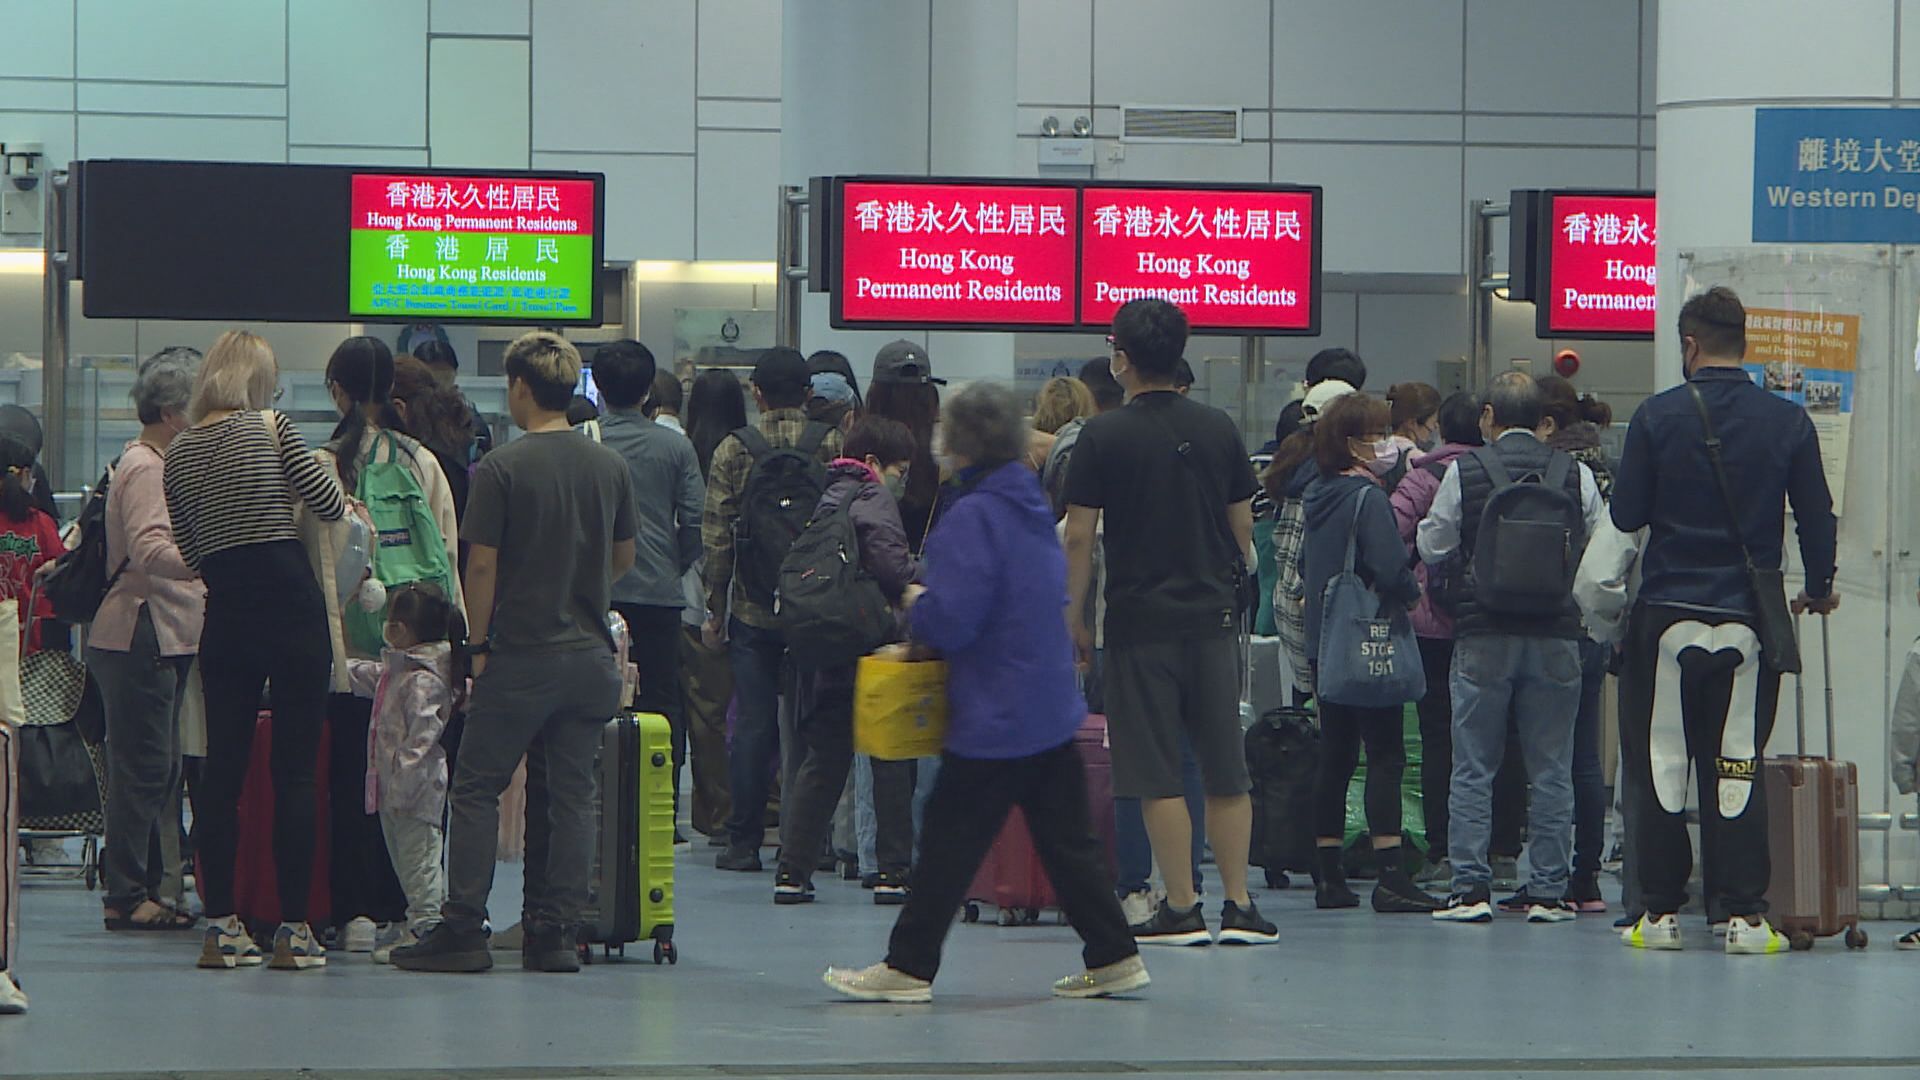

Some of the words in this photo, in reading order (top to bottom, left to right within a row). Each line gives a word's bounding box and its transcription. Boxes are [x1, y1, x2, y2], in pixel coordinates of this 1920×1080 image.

[1798, 137, 1920, 172] 離境大堂
[386, 181, 560, 212] 香港永久性居民
[1767, 186, 1876, 208] Western
[367, 212, 402, 230] Hong
[407, 213, 441, 231] Kong
[446, 214, 513, 229] Permanent
[517, 216, 577, 231] Residents
[854, 199, 1065, 236] 香港永久性居民
[1093, 204, 1301, 241] 香港永久性居民
[1563, 212, 1656, 246] 香港永
[385, 234, 559, 264] 香港居民
[899, 248, 954, 274] Hong
[959, 249, 1014, 274] Kong
[397, 264, 435, 281] Hong
[439, 265, 477, 282] Kong
[481, 266, 546, 281] Residents
[1136, 252, 1191, 279] Hong
[1196, 254, 1250, 279] Kong
[1605, 259, 1656, 285] Hong
[856, 278, 962, 299] Permanent
[967, 279, 1062, 301] Residents
[1095, 282, 1199, 303] Permanent
[1203, 283, 1296, 306] Residents
[1784, 334, 1816, 349] Privacy
[1820, 336, 1848, 351] Policy
